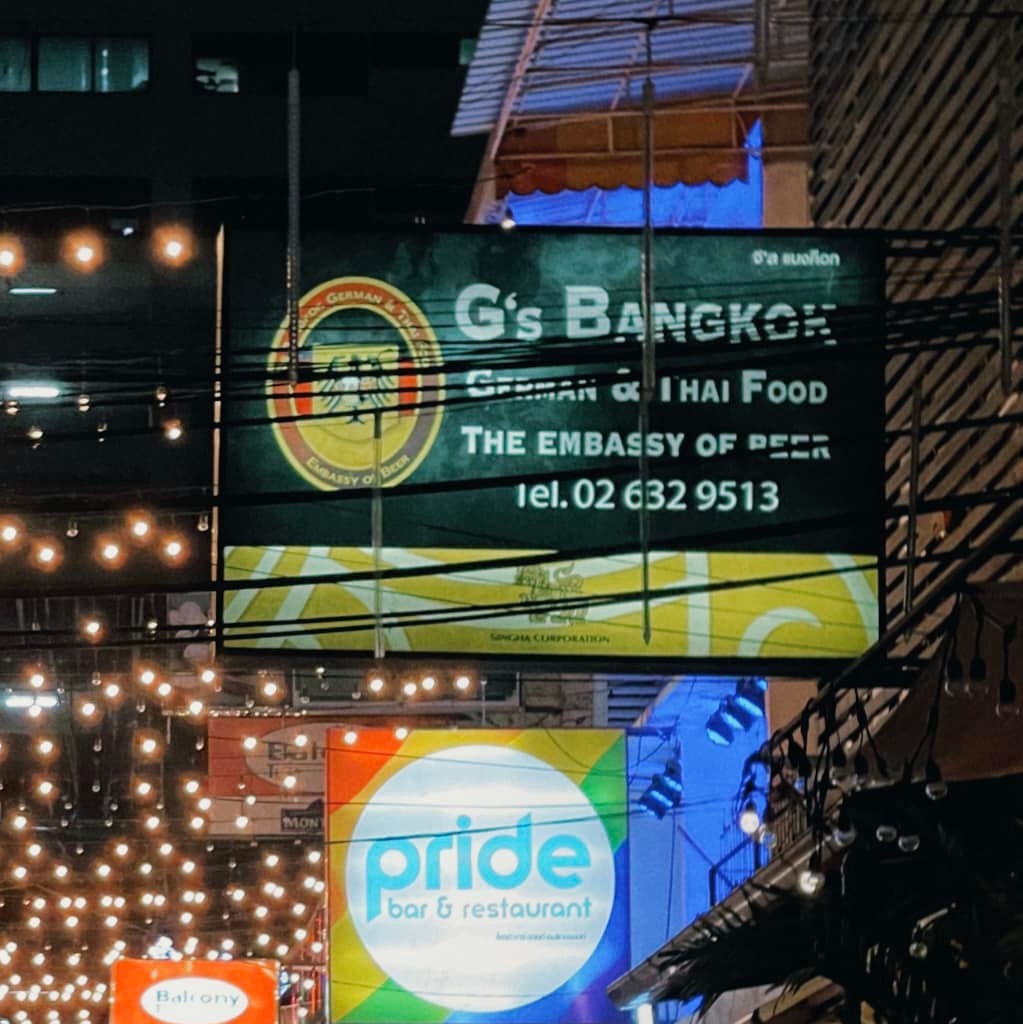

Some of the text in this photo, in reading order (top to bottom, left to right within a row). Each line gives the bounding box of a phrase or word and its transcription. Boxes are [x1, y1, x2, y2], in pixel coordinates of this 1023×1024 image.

[742, 369, 828, 403] FOOD
[461, 425, 526, 455] THE
[538, 431, 685, 457] EMBASSY
[696, 433, 737, 457] OF
[575, 478, 616, 510] 02
[624, 479, 687, 510] 632
[696, 480, 780, 512] 9513
[366, 813, 592, 923] pride
[387, 896, 593, 919] bar & restaurant
